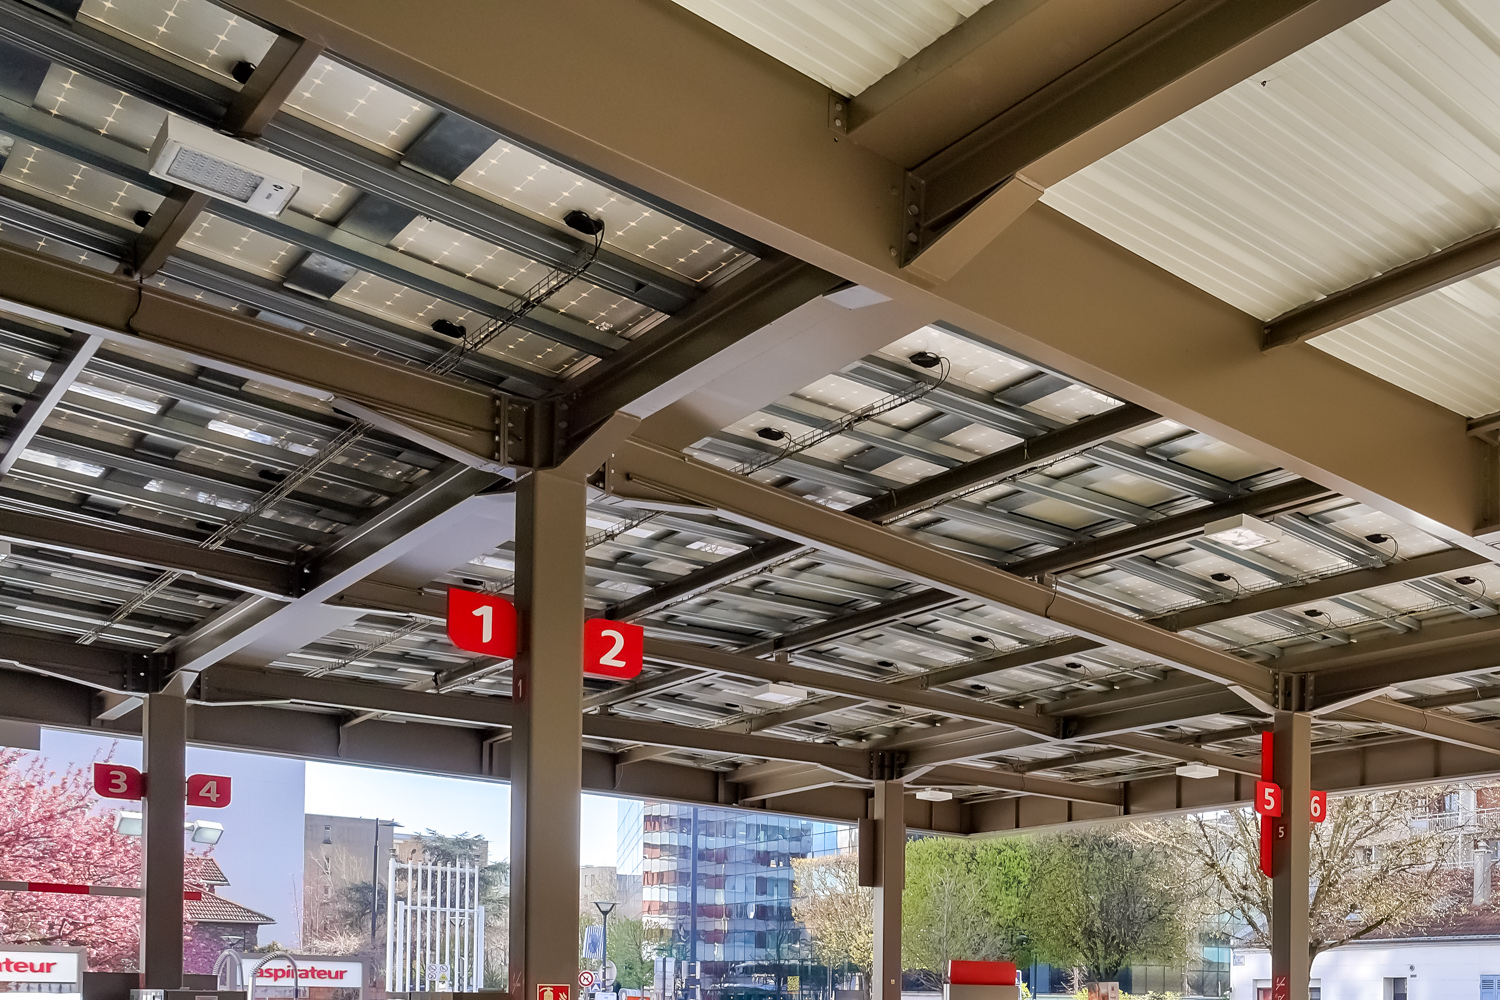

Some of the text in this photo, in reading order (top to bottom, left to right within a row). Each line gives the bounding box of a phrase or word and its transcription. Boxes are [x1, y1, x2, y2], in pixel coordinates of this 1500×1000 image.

[472, 605, 493, 643] 1
[599, 629, 626, 668] 2
[108, 770, 128, 793] 3
[199, 781, 220, 802] 4
[1264, 788, 1275, 810] 5
[1311, 796, 1321, 817] 6
[1279, 827, 1285, 838] 5
[0, 957, 57, 973] teur
[256, 965, 348, 982] aspirateur
